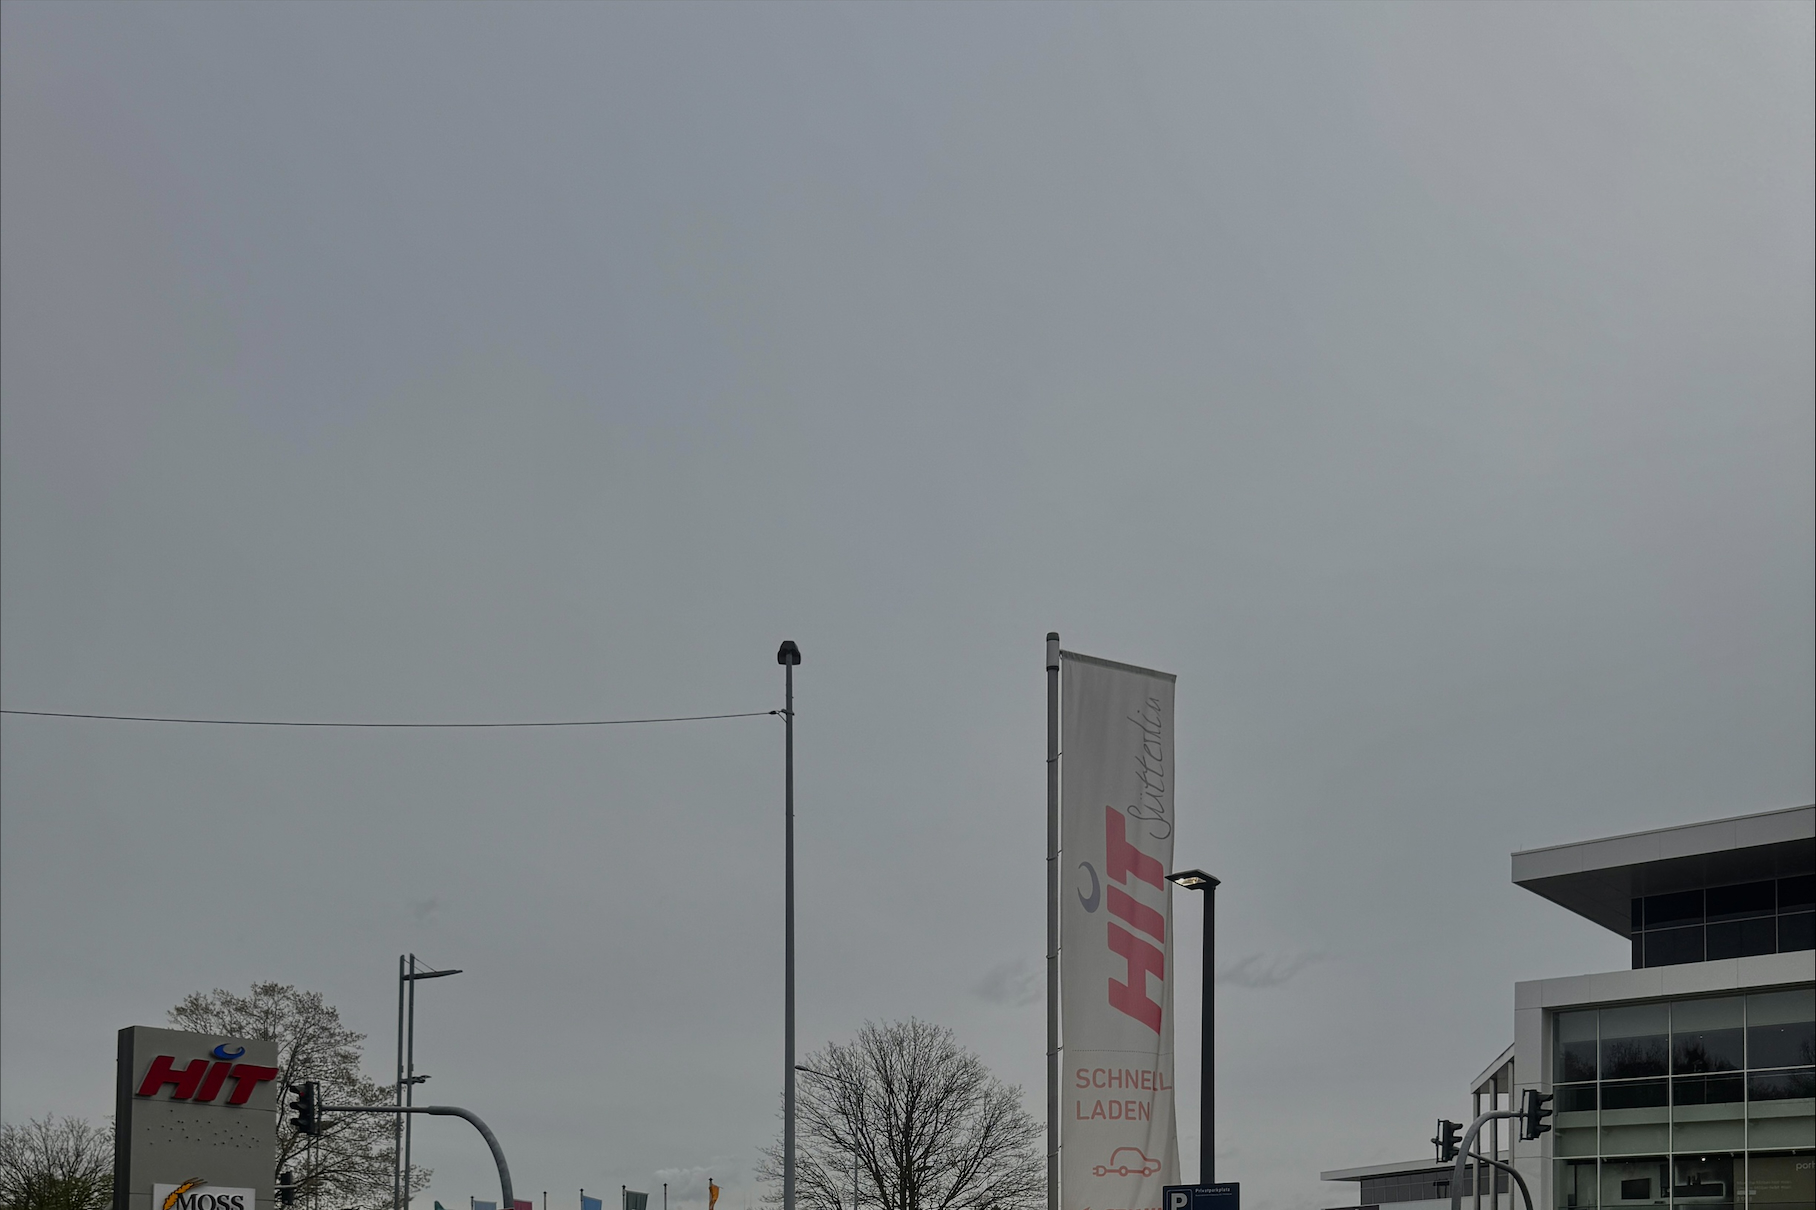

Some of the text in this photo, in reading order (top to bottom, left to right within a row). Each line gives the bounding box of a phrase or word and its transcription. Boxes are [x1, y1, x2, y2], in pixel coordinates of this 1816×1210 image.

[1106, 805, 1165, 1036] HIT
[138, 1054, 279, 1105] HIT
[1075, 1067, 1173, 1092] SCHNELL
[1075, 1099, 1151, 1121] LADEN
